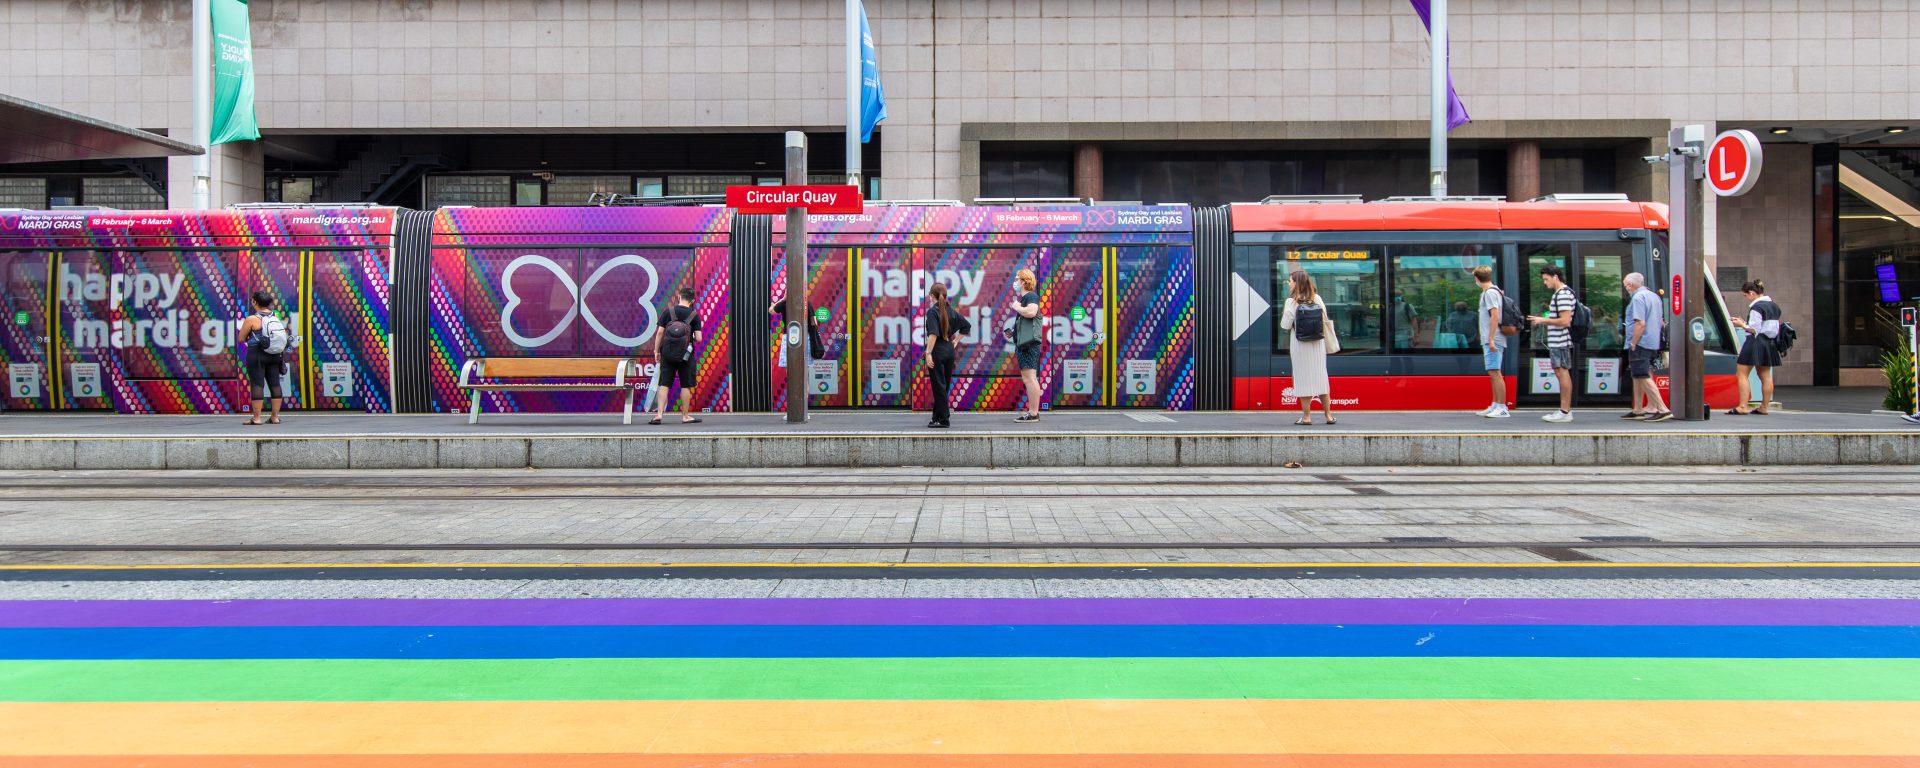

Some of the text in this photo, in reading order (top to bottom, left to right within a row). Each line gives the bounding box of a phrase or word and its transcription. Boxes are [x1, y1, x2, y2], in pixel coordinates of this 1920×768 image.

[1720, 146, 1736, 182] L
[746, 190, 837, 205] Circular Quay
[101, 218, 135, 226] February
[292, 215, 385, 226] mardigras.org.au
[778, 214, 872, 223] migras.org.au
[1006, 214, 1040, 222] February
[1118, 216, 1182, 224] MARDI GRAS
[18, 220, 82, 229] MARDI GRAS
[1306, 251, 1340, 259] Circular
[1343, 251, 1367, 259] Quay
[60, 262, 184, 308] happy
[861, 258, 984, 307] happy
[75, 308, 190, 350] mardi
